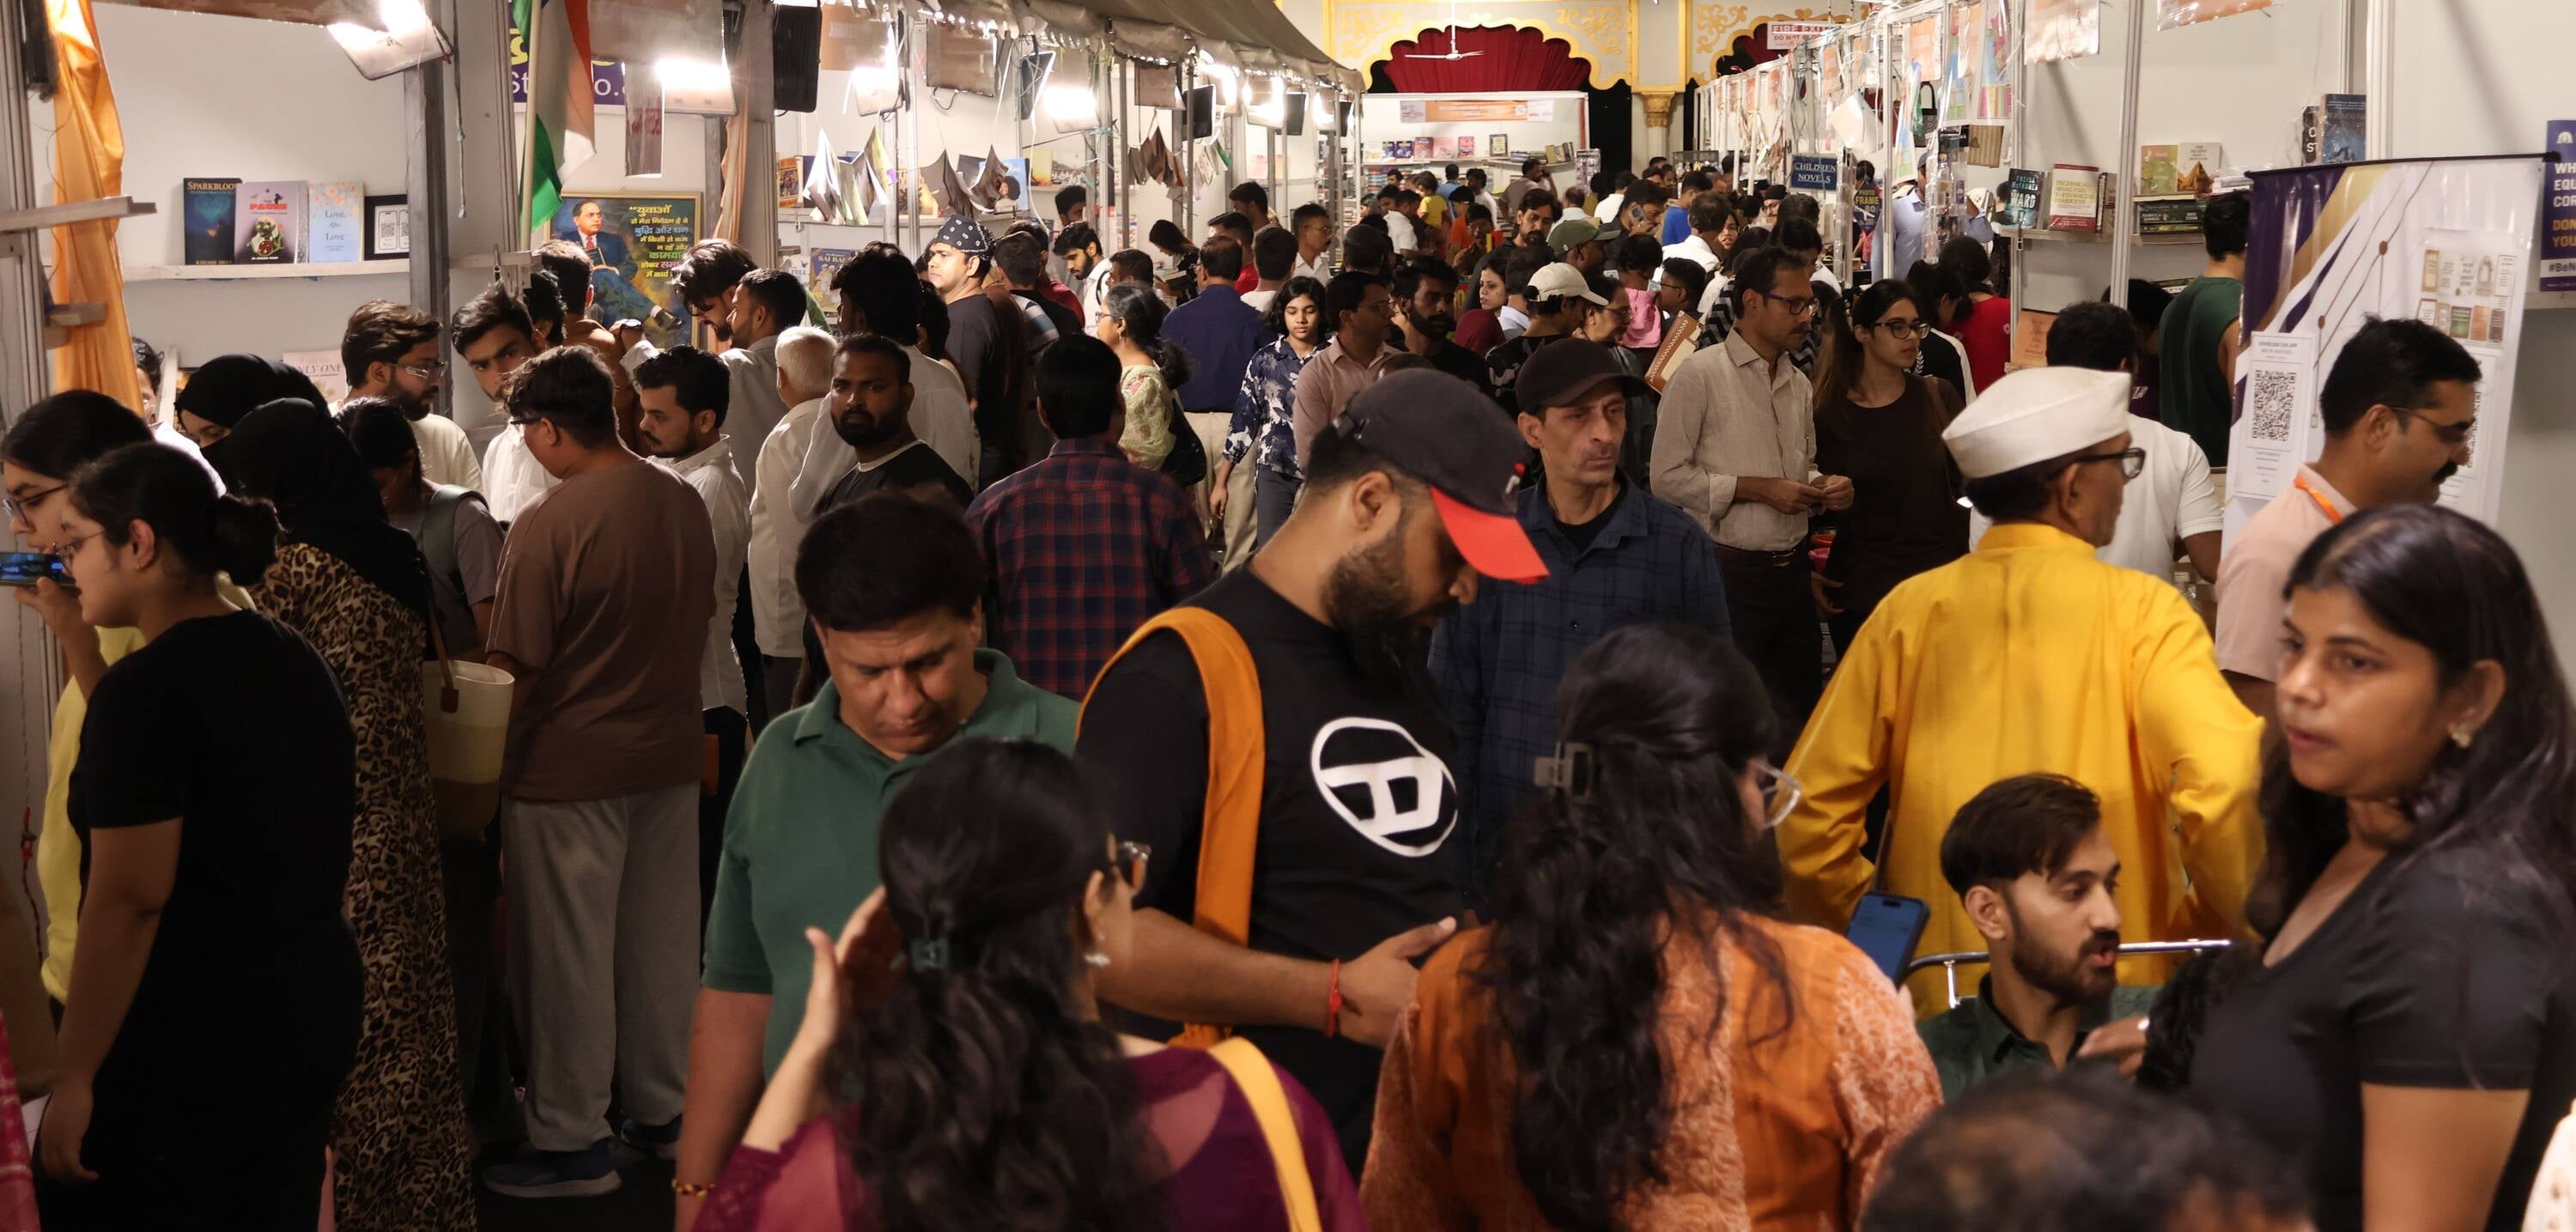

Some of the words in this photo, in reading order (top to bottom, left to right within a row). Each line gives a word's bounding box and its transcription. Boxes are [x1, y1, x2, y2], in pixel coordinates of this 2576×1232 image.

[1795, 163, 1837, 173] CHILDREN
[187, 181, 235, 191] SPARKBLOO
[1855, 197, 1880, 205] FRAME
[2010, 191, 2037, 209] WARD
[325, 233, 344, 241] Love
[320, 363, 343, 373] ONE
